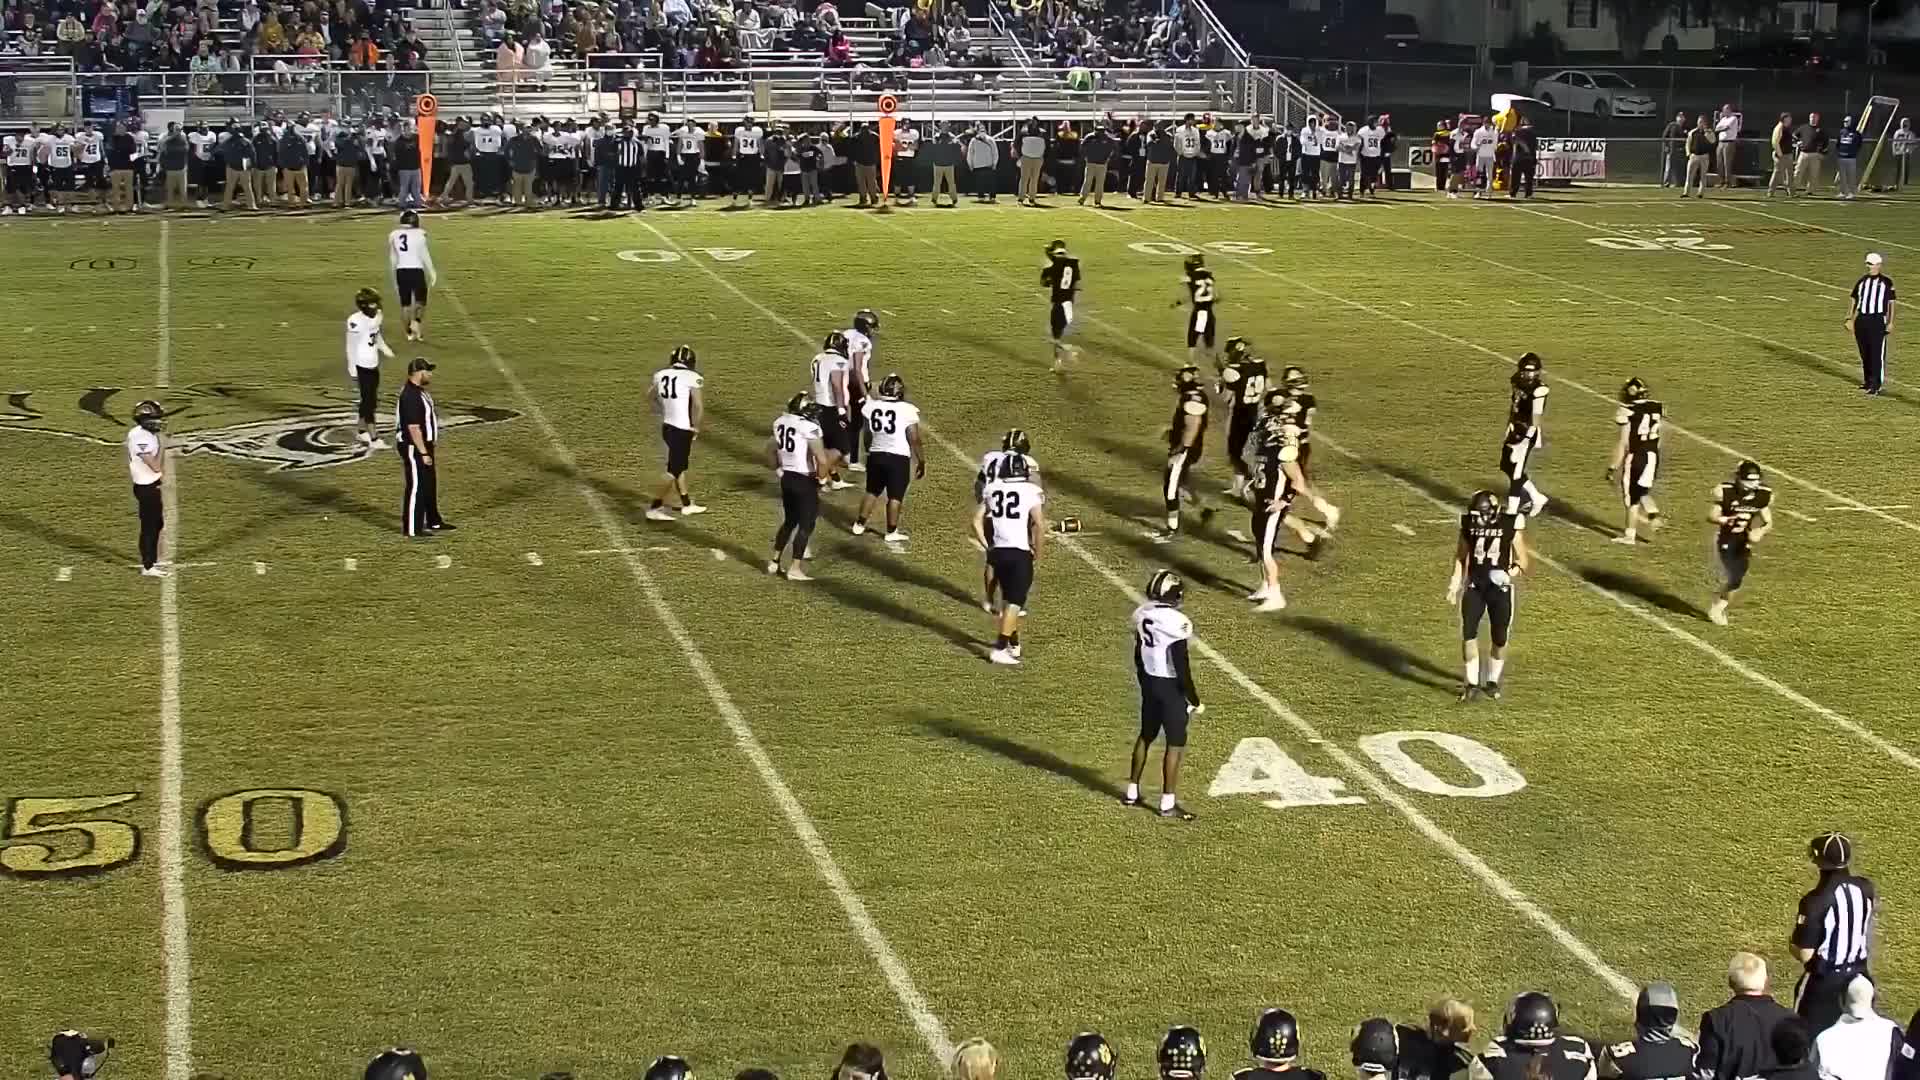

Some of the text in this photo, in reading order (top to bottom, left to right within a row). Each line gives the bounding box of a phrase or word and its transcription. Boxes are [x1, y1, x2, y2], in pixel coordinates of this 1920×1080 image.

[55, 146, 69, 157] 65
[1411, 149, 1433, 166] 20
[399, 233, 409, 252] 3
[1060, 265, 1073, 290] 8
[660, 375, 678, 399] 31
[870, 408, 897, 435] 63
[776, 424, 796, 453] 36
[991, 490, 1020, 519] 32
[1473, 537, 1501, 566] 44
[1208, 731, 1528, 809] 40
[0, 788, 349, 876] 50
